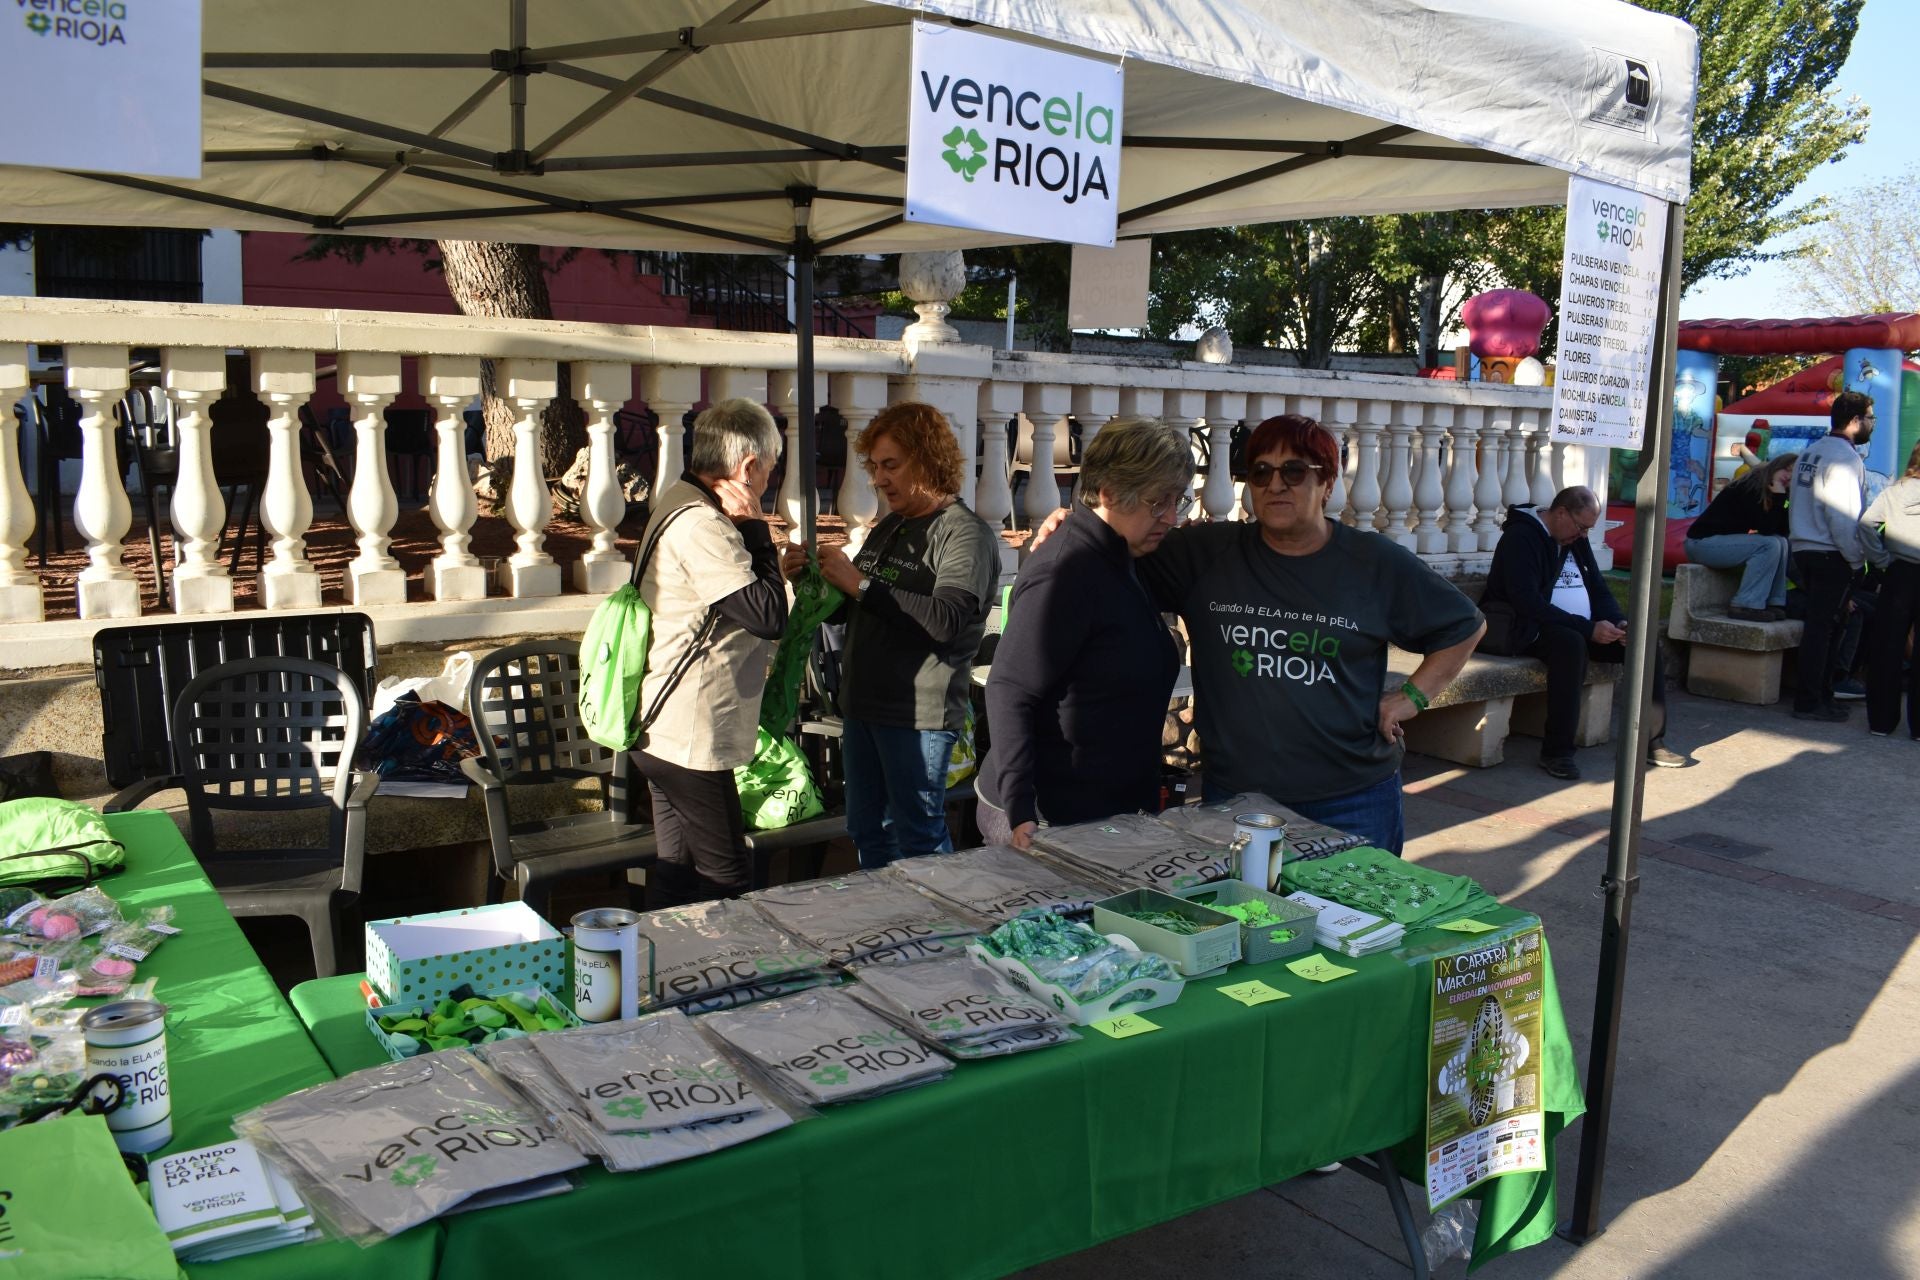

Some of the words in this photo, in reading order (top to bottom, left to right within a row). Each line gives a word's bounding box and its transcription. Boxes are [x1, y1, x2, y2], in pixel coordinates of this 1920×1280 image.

[56, 17, 126, 46] RIOJA
[921, 70, 1113, 145] vencela
[994, 138, 1109, 204] RIOJA
[1592, 198, 1647, 227] vencela
[1611, 225, 1643, 251] RIOJA
[1571, 253, 1608, 271] PULSERAS
[1610, 262, 1639, 278] VENCELA
[1569, 272, 1599, 288] CHAPAS
[1600, 279, 1631, 296] VENCELA
[1568, 292, 1605, 309] LLAVEROS
[1606, 299, 1631, 314] TREBOL
[1567, 311, 1604, 328] PULSERAS
[1604, 318, 1628, 333] NUDOS
[1565, 330, 1602, 347] LLAVEROS
[1603, 336, 1628, 351] TREBOL
[1564, 349, 1591, 364] FLORES
[1562, 369, 1598, 384] LLAVEROS
[1560, 388, 1596, 403] MOCHILAS
[1597, 392, 1626, 407] VENCELA
[1559, 407, 1597, 422] CAMISETAS
[1209, 601, 1243, 614] Cuando
[1244, 604, 1255, 614] la
[1257, 606, 1282, 618] ELA
[1284, 611, 1299, 620] no
[1302, 612, 1313, 622] te
[1315, 613, 1327, 623] la
[1329, 616, 1359, 631] pELA
[1220, 624, 1341, 658] vencela
[1257, 653, 1336, 686] RIOJA
[1440, 959, 1451, 977] IX
[1456, 946, 1507, 973] CARRERA
[1437, 969, 1486, 994] MARCHA
[120, 1058, 129, 1066] la
[132, 1052, 152, 1064] ELA
[141, 1079, 168, 1105] RIO
[435, 1126, 556, 1162] RIOJA
[163, 1147, 237, 1169] CUANDO
[164, 1165, 187, 1175] LA
[192, 1157, 225, 1169] ELA
[166, 1170, 191, 1182] NO
[199, 1164, 221, 1173] TE
[167, 1177, 190, 1188] LA
[195, 1166, 241, 1181] PELA
[183, 1191, 246, 1209] vencela
[207, 1197, 247, 1210] RIOJA
